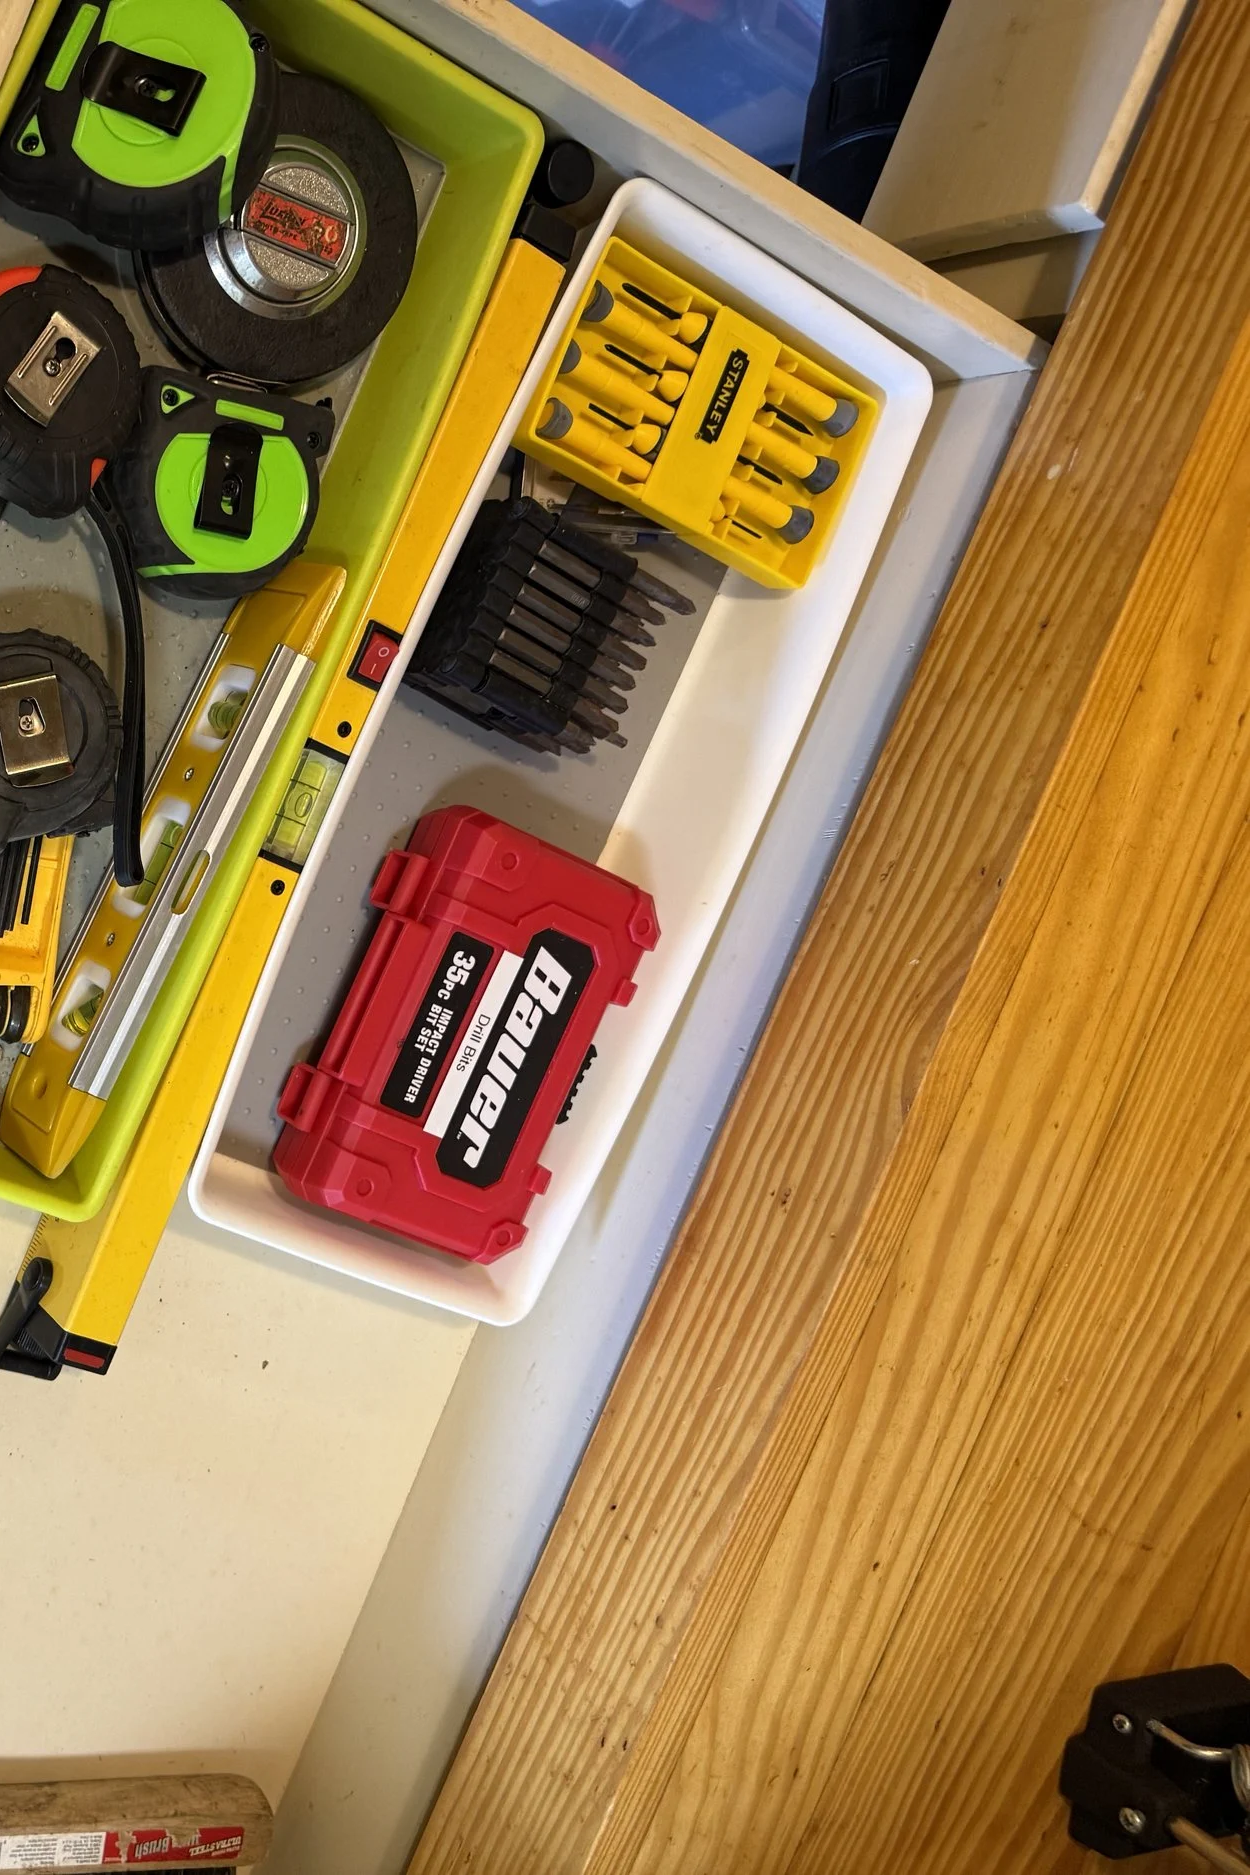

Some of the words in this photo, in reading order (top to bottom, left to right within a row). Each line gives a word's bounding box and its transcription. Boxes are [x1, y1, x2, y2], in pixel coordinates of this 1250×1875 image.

[706, 356, 744, 436] STANLEY
[437, 950, 476, 1001] 35PC
[426, 1003, 442, 1026] BIT
[426, 1008, 454, 1057] IMPACT
[469, 1013, 491, 1043] Drill
[414, 1026, 432, 1052] SET
[460, 945, 573, 1169] Bauer
[456, 1045, 476, 1072] Bits
[404, 1057, 432, 1104] DRIVER
[134, 1836, 170, 1860] Brush
